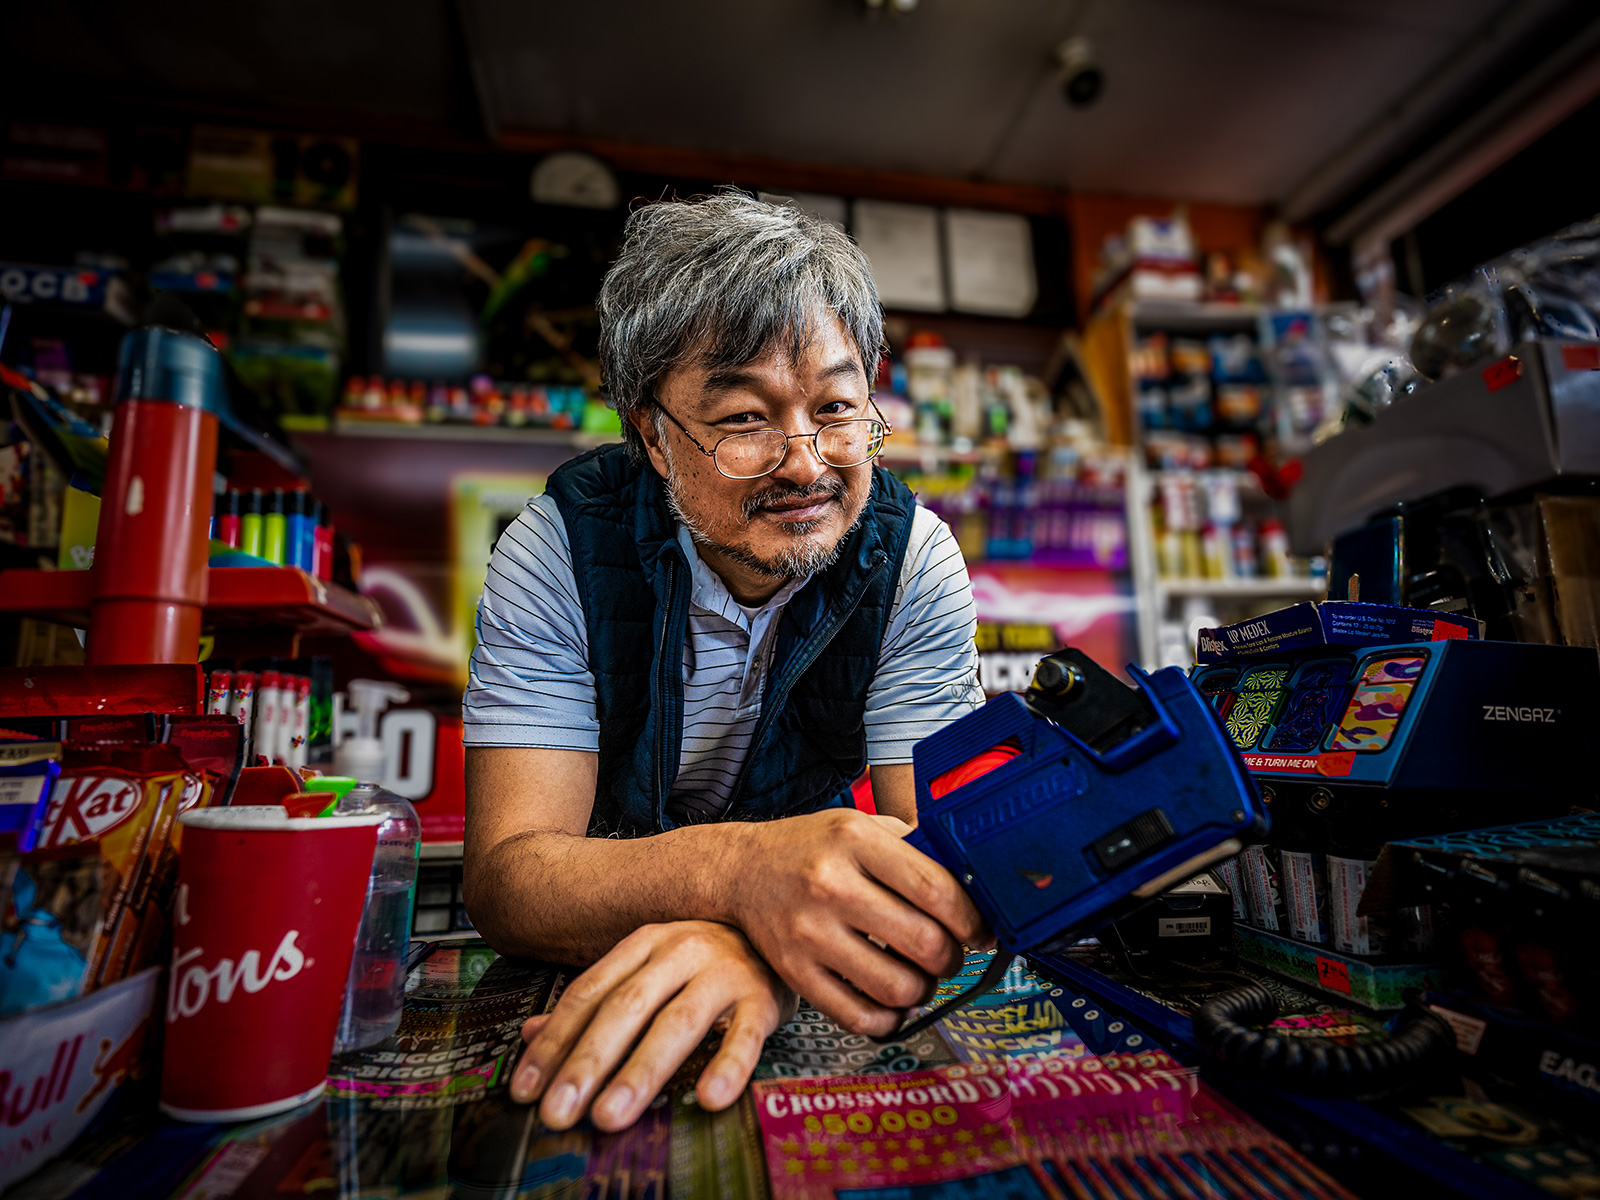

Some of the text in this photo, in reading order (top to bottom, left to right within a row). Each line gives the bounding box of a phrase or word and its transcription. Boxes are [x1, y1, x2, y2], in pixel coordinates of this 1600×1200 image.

[0, 269, 90, 302] OCB
[1238, 620, 1271, 642] MEDEX
[1200, 636, 1229, 657] Blistex
[1482, 705, 1556, 723] ZENGAZ
[1243, 757, 1256, 766] ME
[1256, 757, 1264, 766] &
[1264, 758, 1288, 768] TURN
[1287, 759, 1303, 768] ME
[1302, 760, 1318, 769] ON
[941, 1016, 1050, 1035] LUCKY
[950, 1030, 1062, 1050] LUCKY
[373, 1041, 488, 1064] BIGGER
[356, 1057, 475, 1079] BIGGER
[766, 1080, 981, 1119] CROSSWORD
[803, 1105, 960, 1135] $50,000
